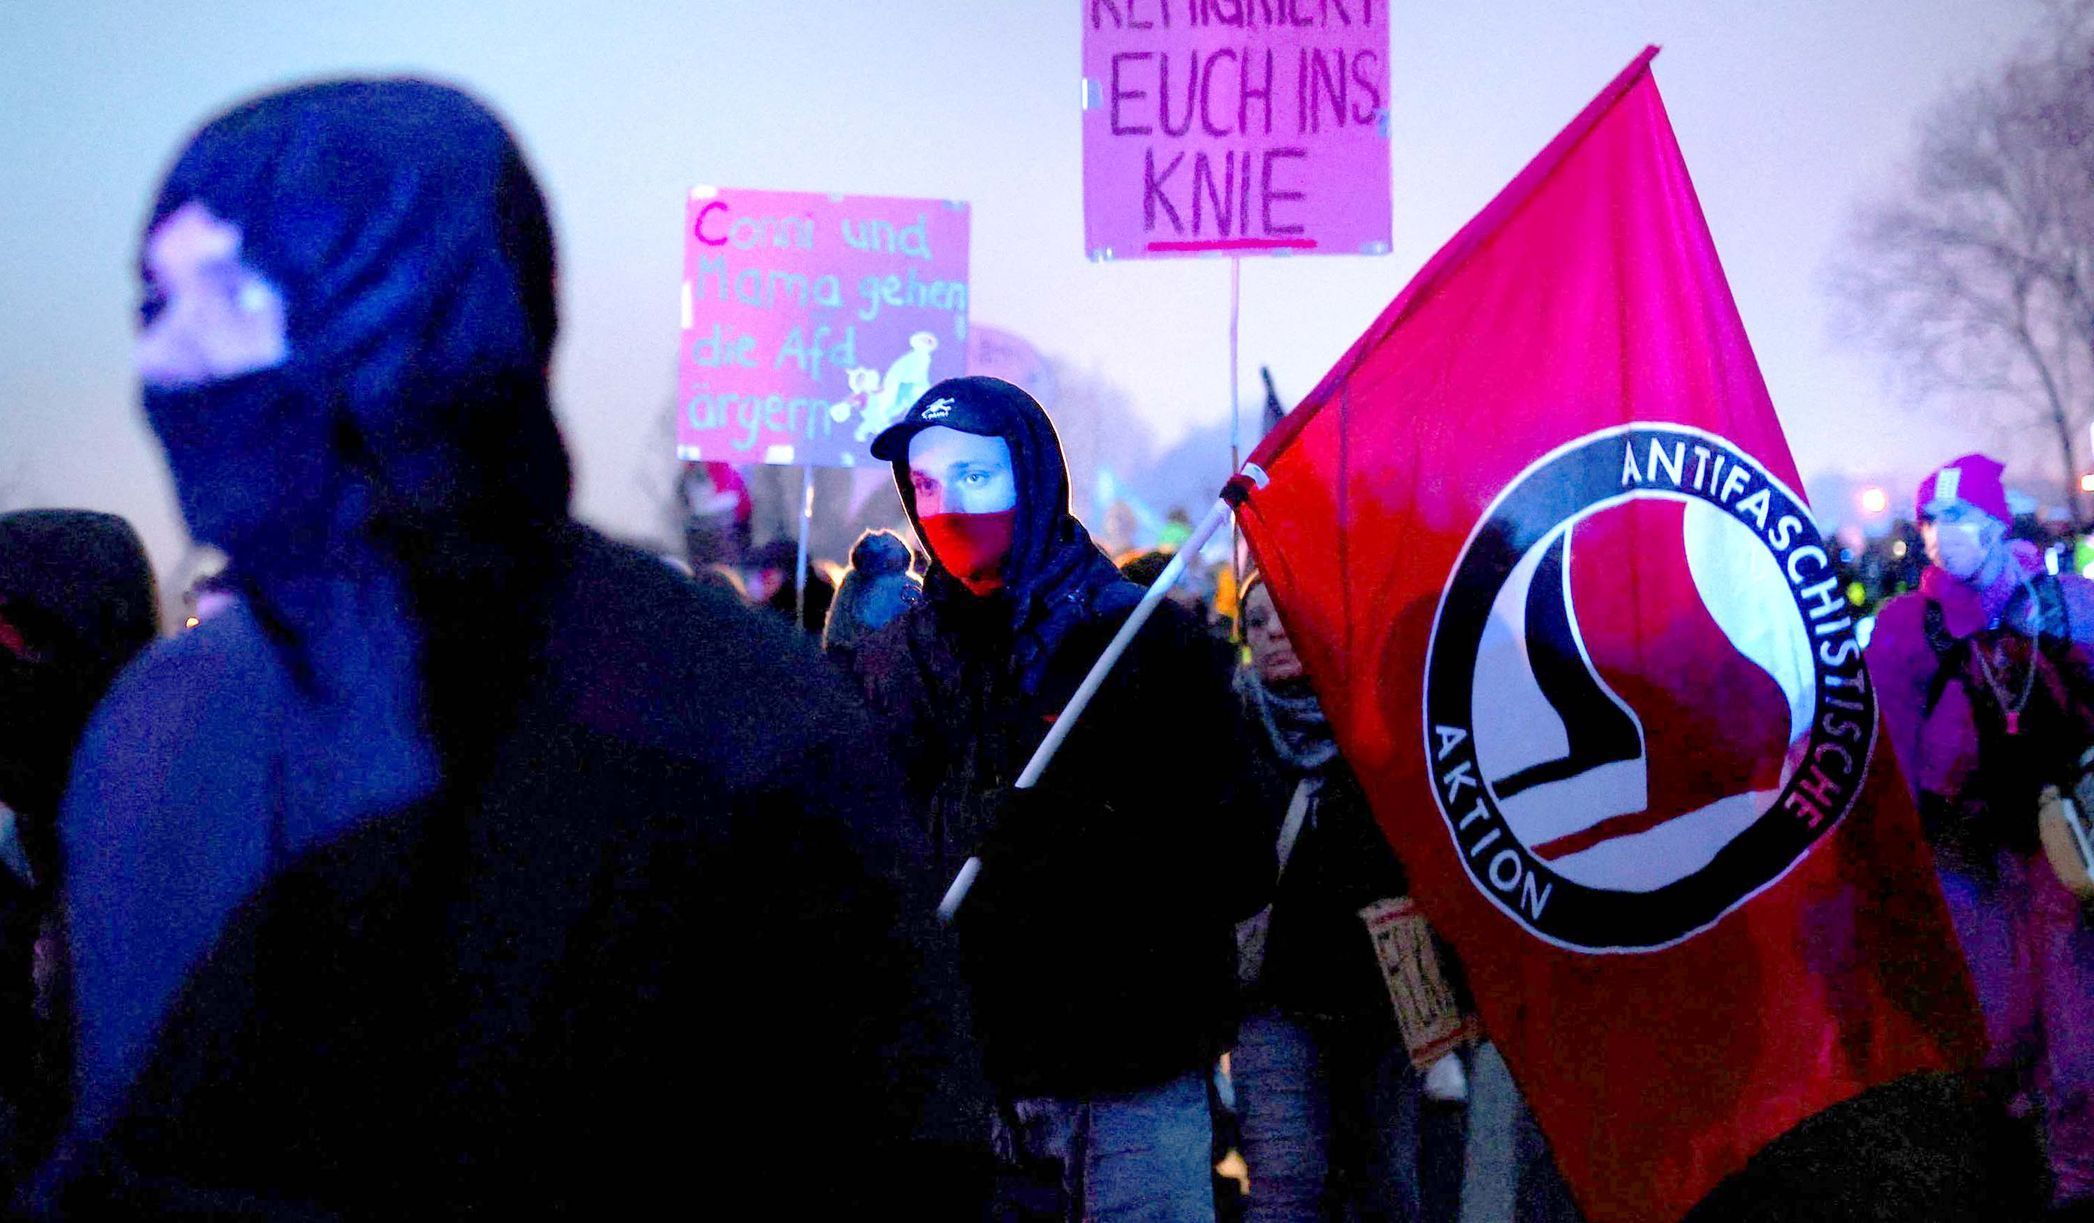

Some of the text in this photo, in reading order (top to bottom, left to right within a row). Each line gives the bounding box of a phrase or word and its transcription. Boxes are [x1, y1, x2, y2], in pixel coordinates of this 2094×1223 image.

[1110, 47, 1381, 138] EUCH INS
[1143, 147, 1308, 236] KNIE
[694, 201, 934, 262] Conni und
[698, 254, 969, 322] Mama gehen
[692, 322, 858, 382] die Afd
[687, 382, 832, 450] ärgern
[1620, 437, 1868, 829] ANTIFASCHISTISCHE
[1434, 723, 1553, 921] AKTION
